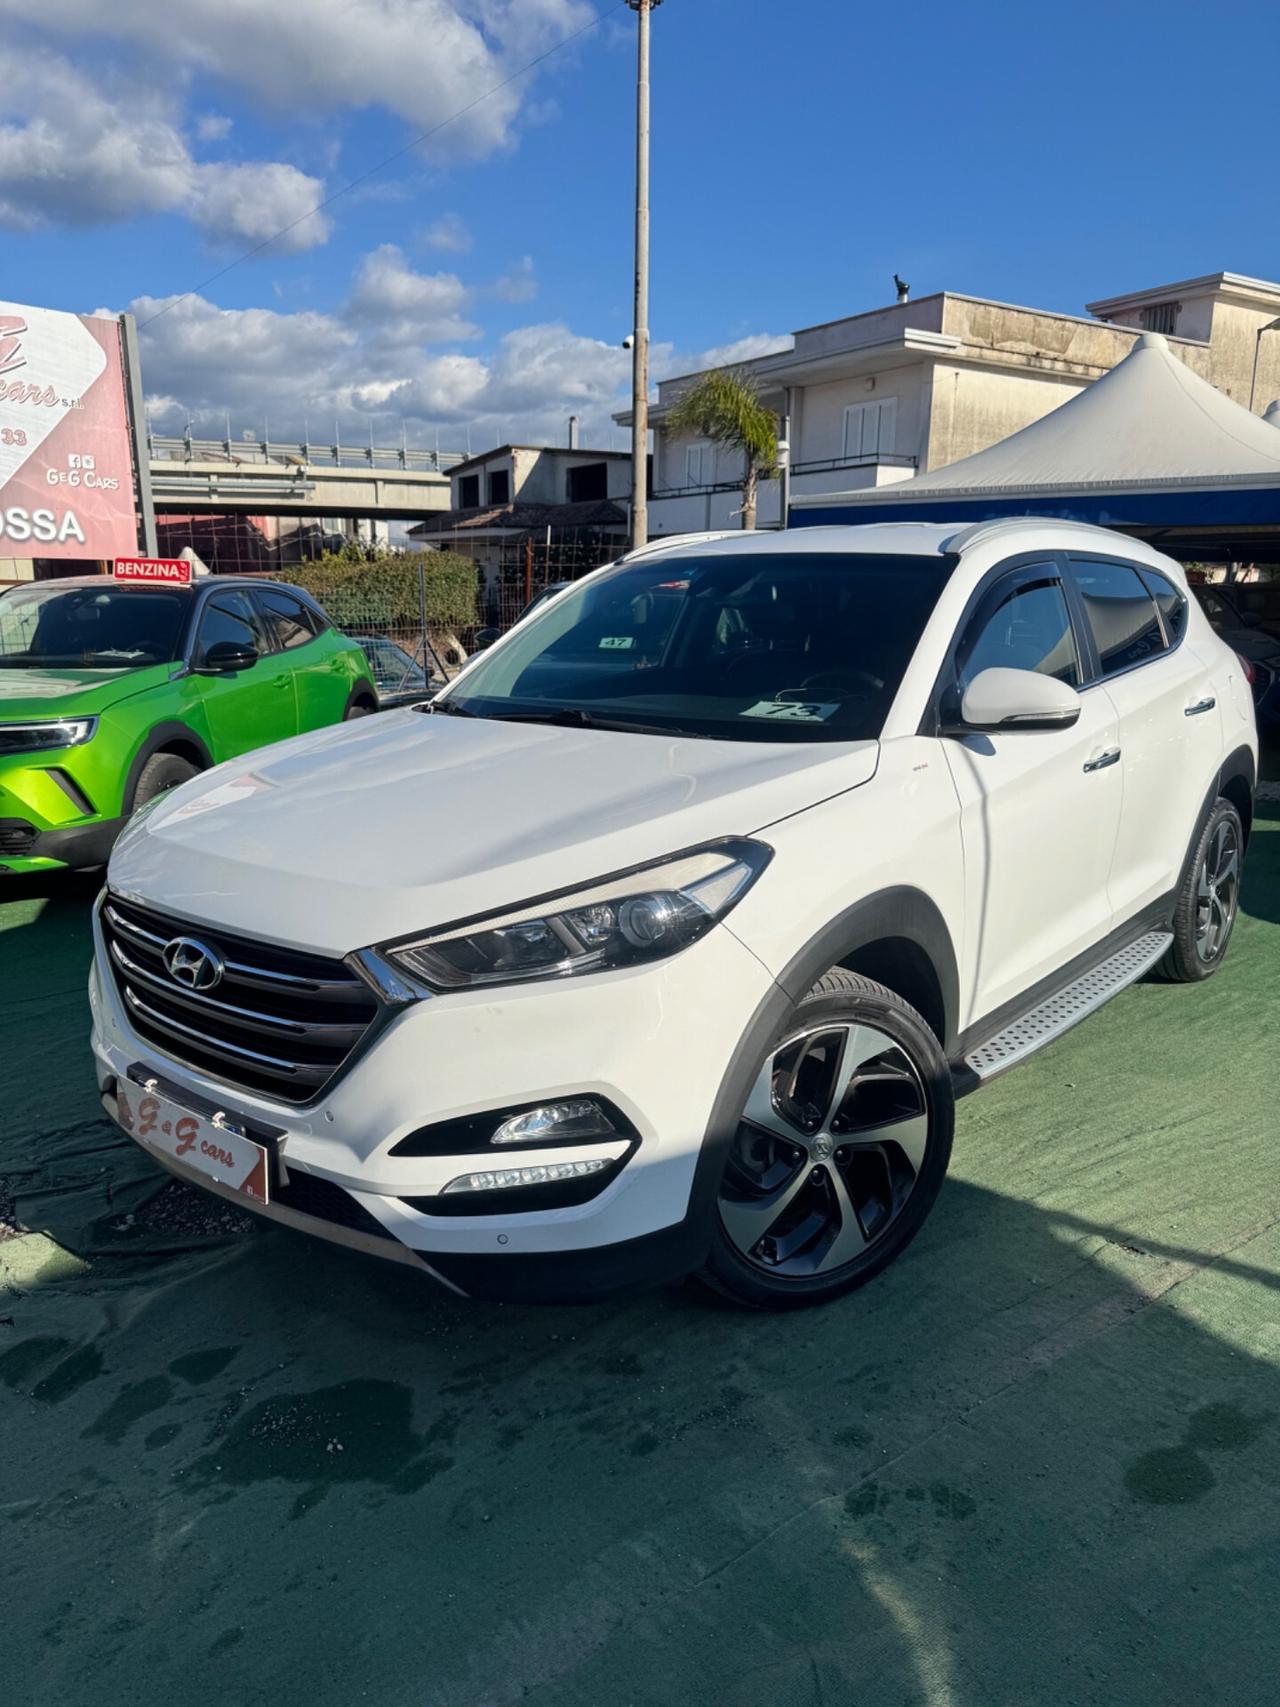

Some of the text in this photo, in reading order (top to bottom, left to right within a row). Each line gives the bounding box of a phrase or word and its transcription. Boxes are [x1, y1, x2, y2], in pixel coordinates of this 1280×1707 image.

[0, 507, 86, 543] SSA
[116, 561, 180, 578] BENZINA
[765, 703, 822, 717] 73
[201, 1140, 235, 1168] cars
